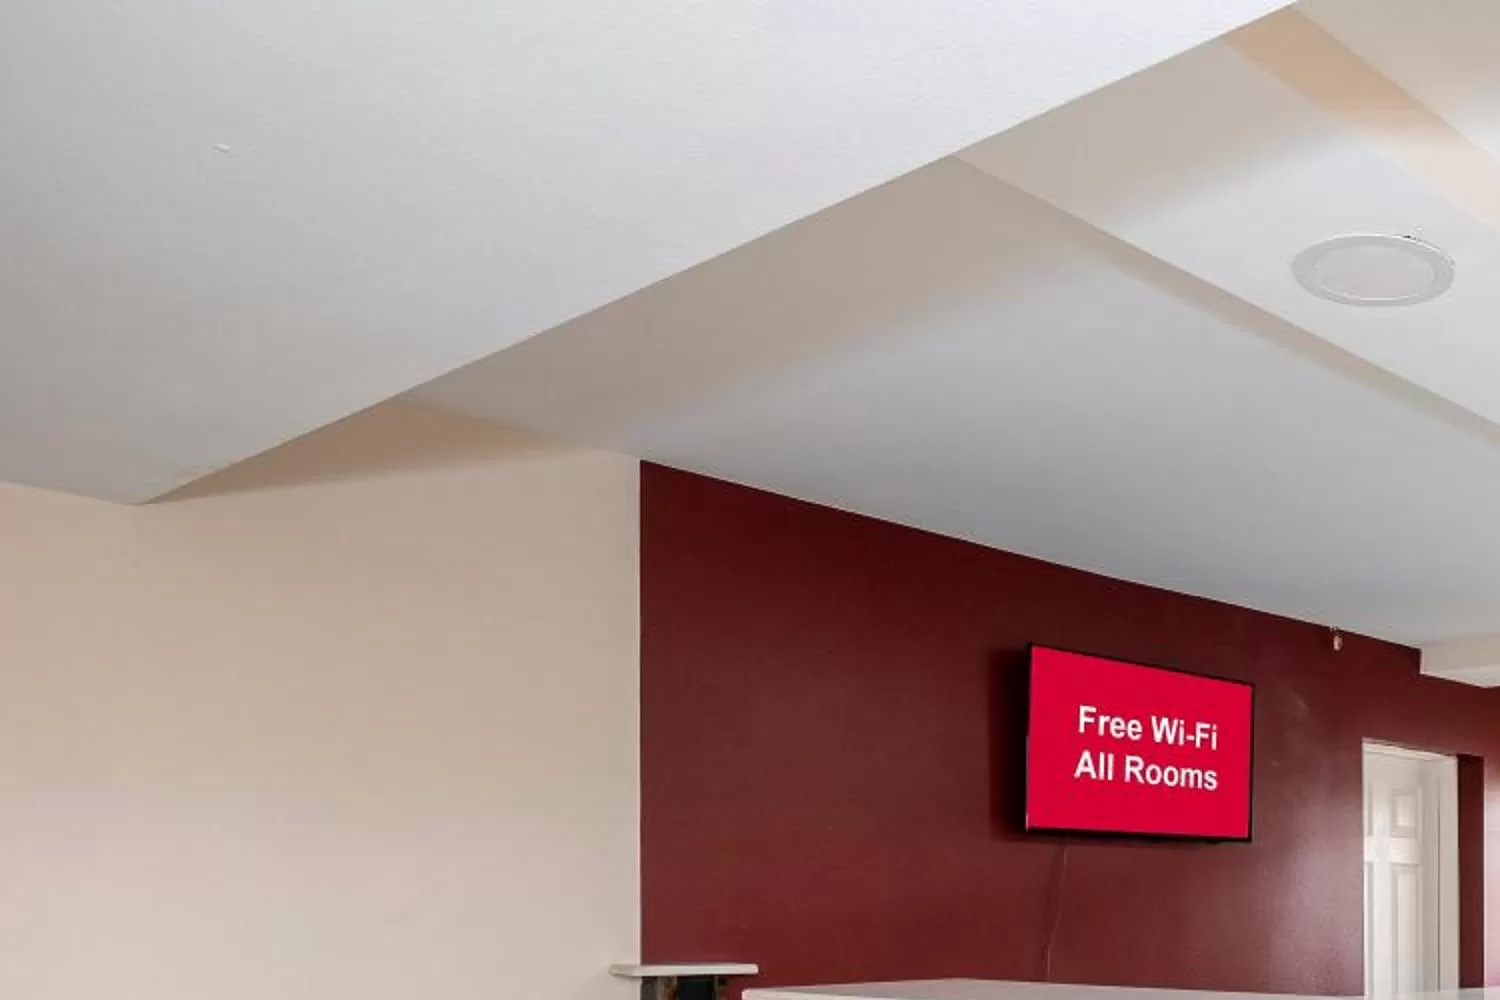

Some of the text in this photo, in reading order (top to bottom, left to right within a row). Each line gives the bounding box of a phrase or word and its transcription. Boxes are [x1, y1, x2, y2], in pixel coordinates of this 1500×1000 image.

[1078, 704, 1218, 751] Free Wi-Fi
[1073, 749, 1218, 791] All Rooms
